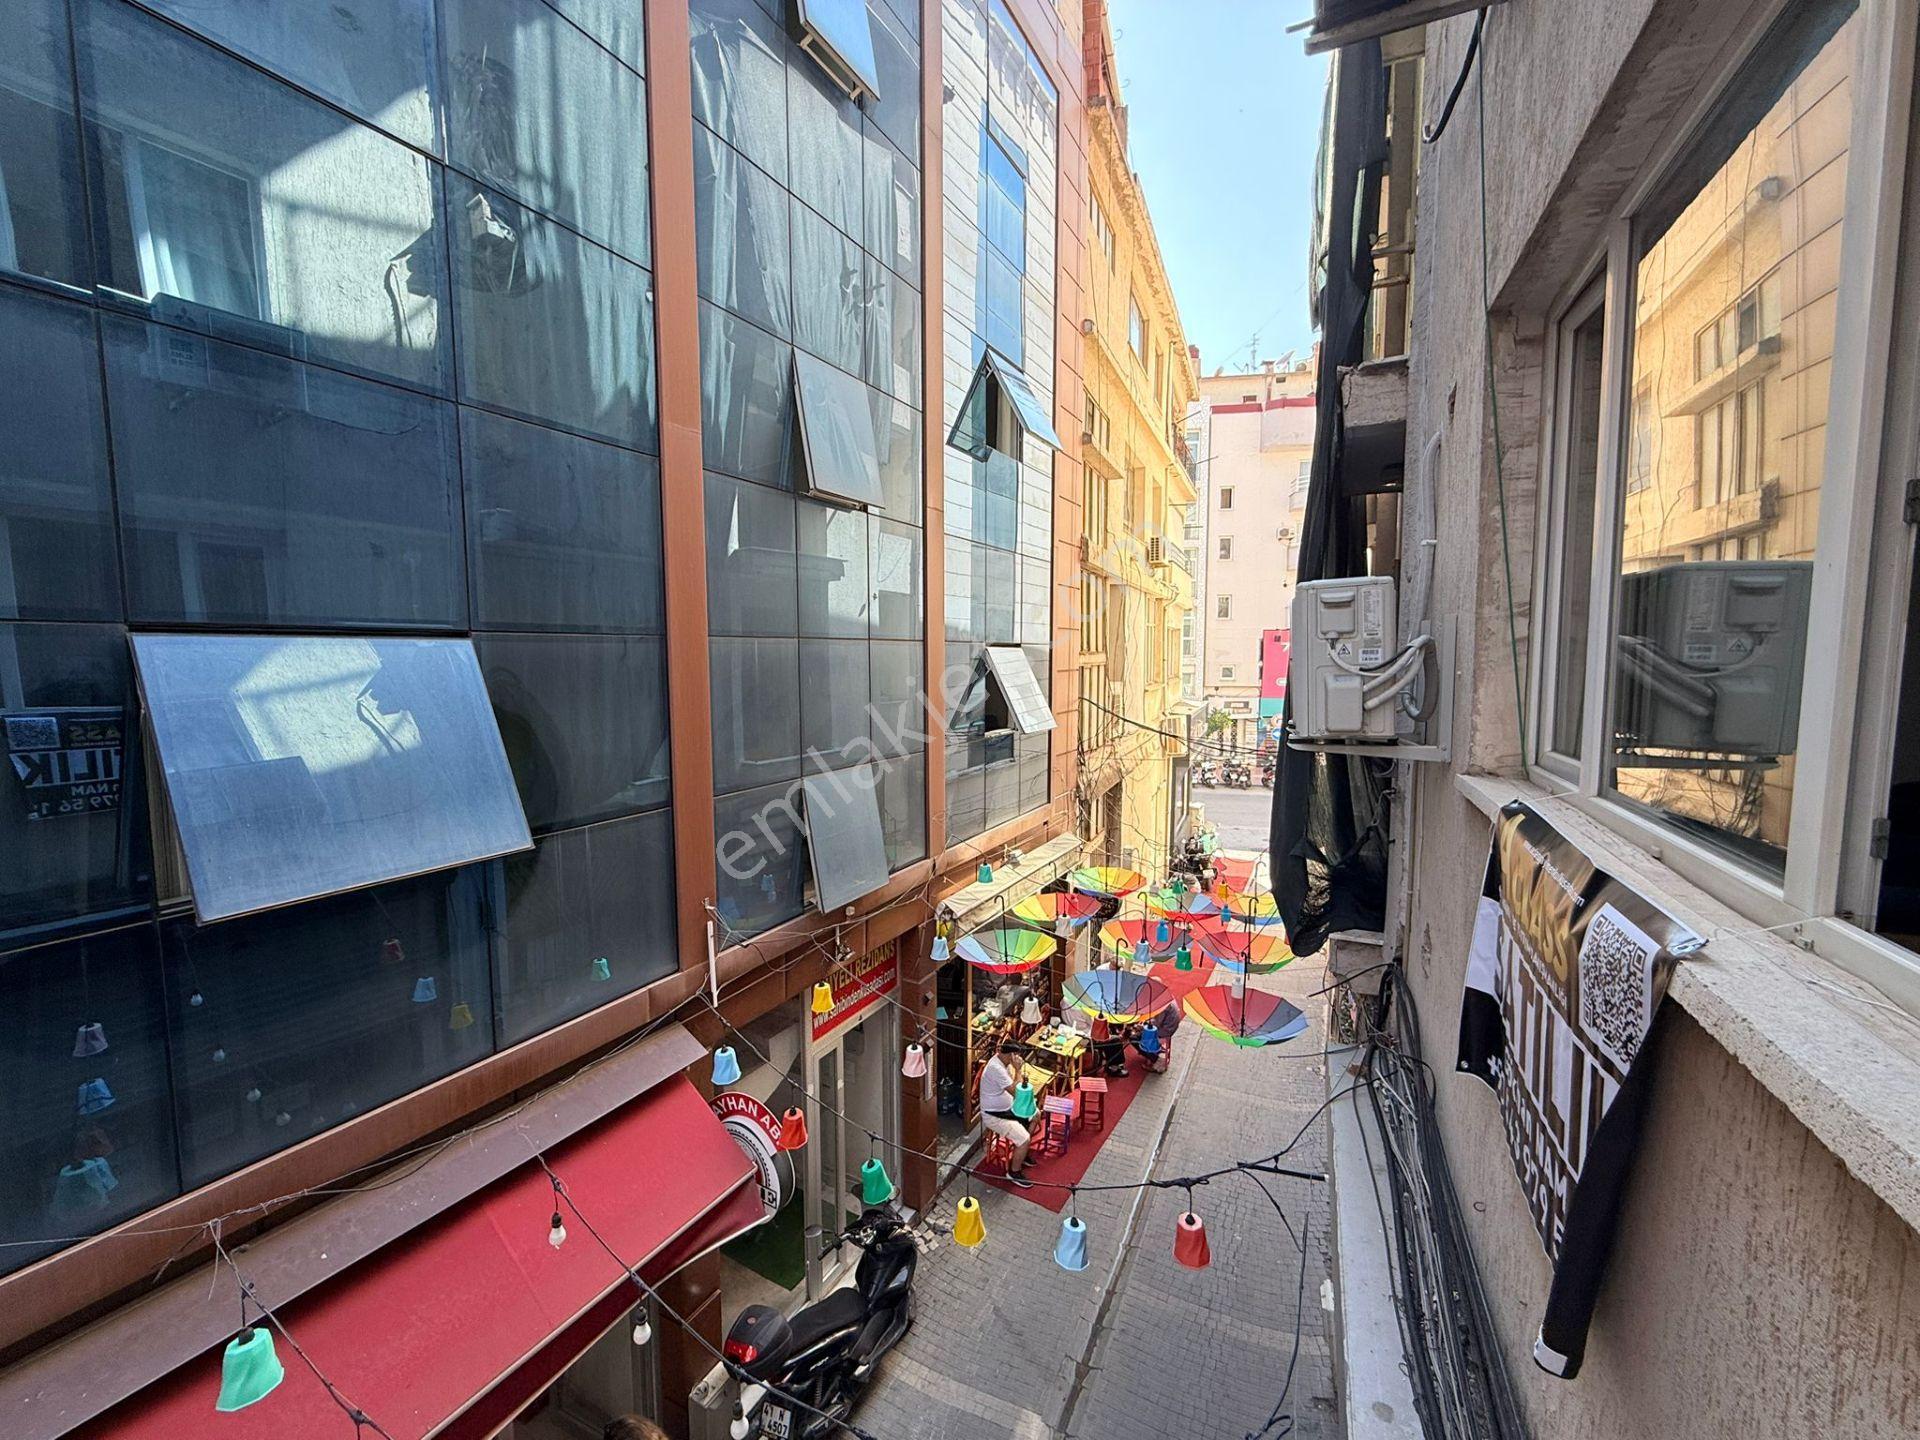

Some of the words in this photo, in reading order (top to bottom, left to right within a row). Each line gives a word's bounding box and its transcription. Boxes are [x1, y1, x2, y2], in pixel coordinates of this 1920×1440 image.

[1536, 1123, 1568, 1214] NAM
[764, 1404, 774, 1417] 41
[767, 1419, 788, 1435] 4507
